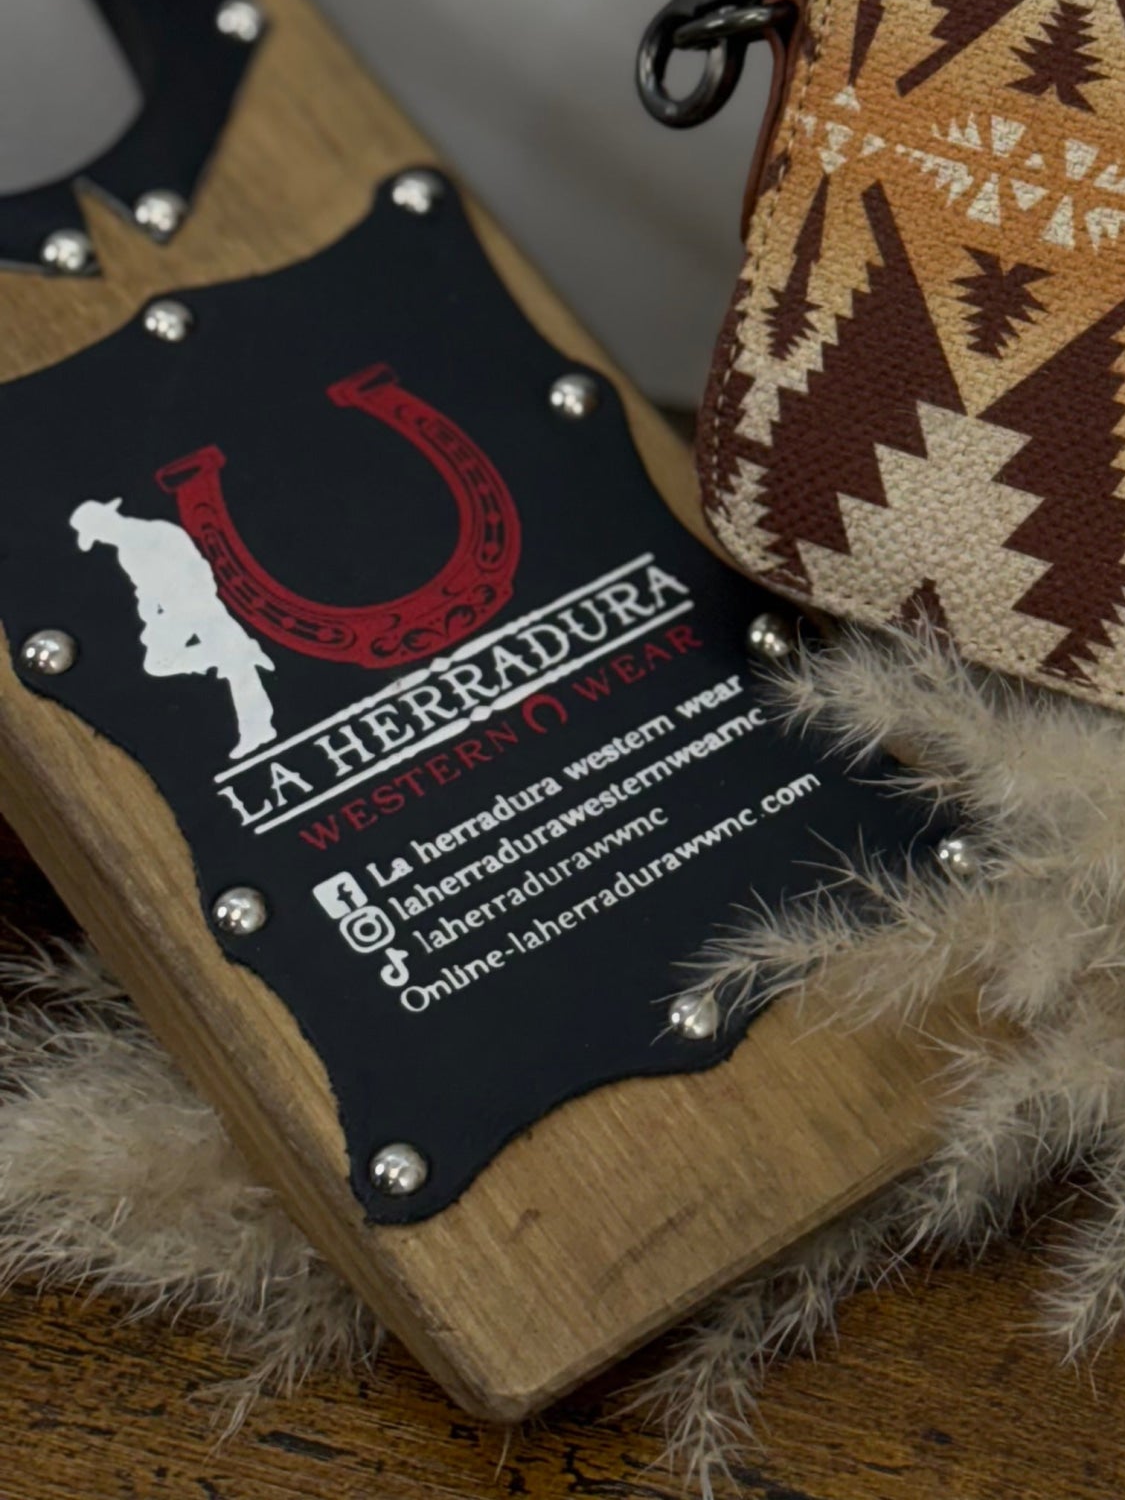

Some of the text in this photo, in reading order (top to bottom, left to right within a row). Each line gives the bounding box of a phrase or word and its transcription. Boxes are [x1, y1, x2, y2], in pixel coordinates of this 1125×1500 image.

[217, 564, 690, 826] LA HERRADURA
[299, 623, 703, 852] WESTERN WEAR
[366, 671, 745, 888] La herradura western wear
[388, 704, 768, 922] laherradurawesternwearnc
[414, 806, 669, 955] laherradurawwnc
